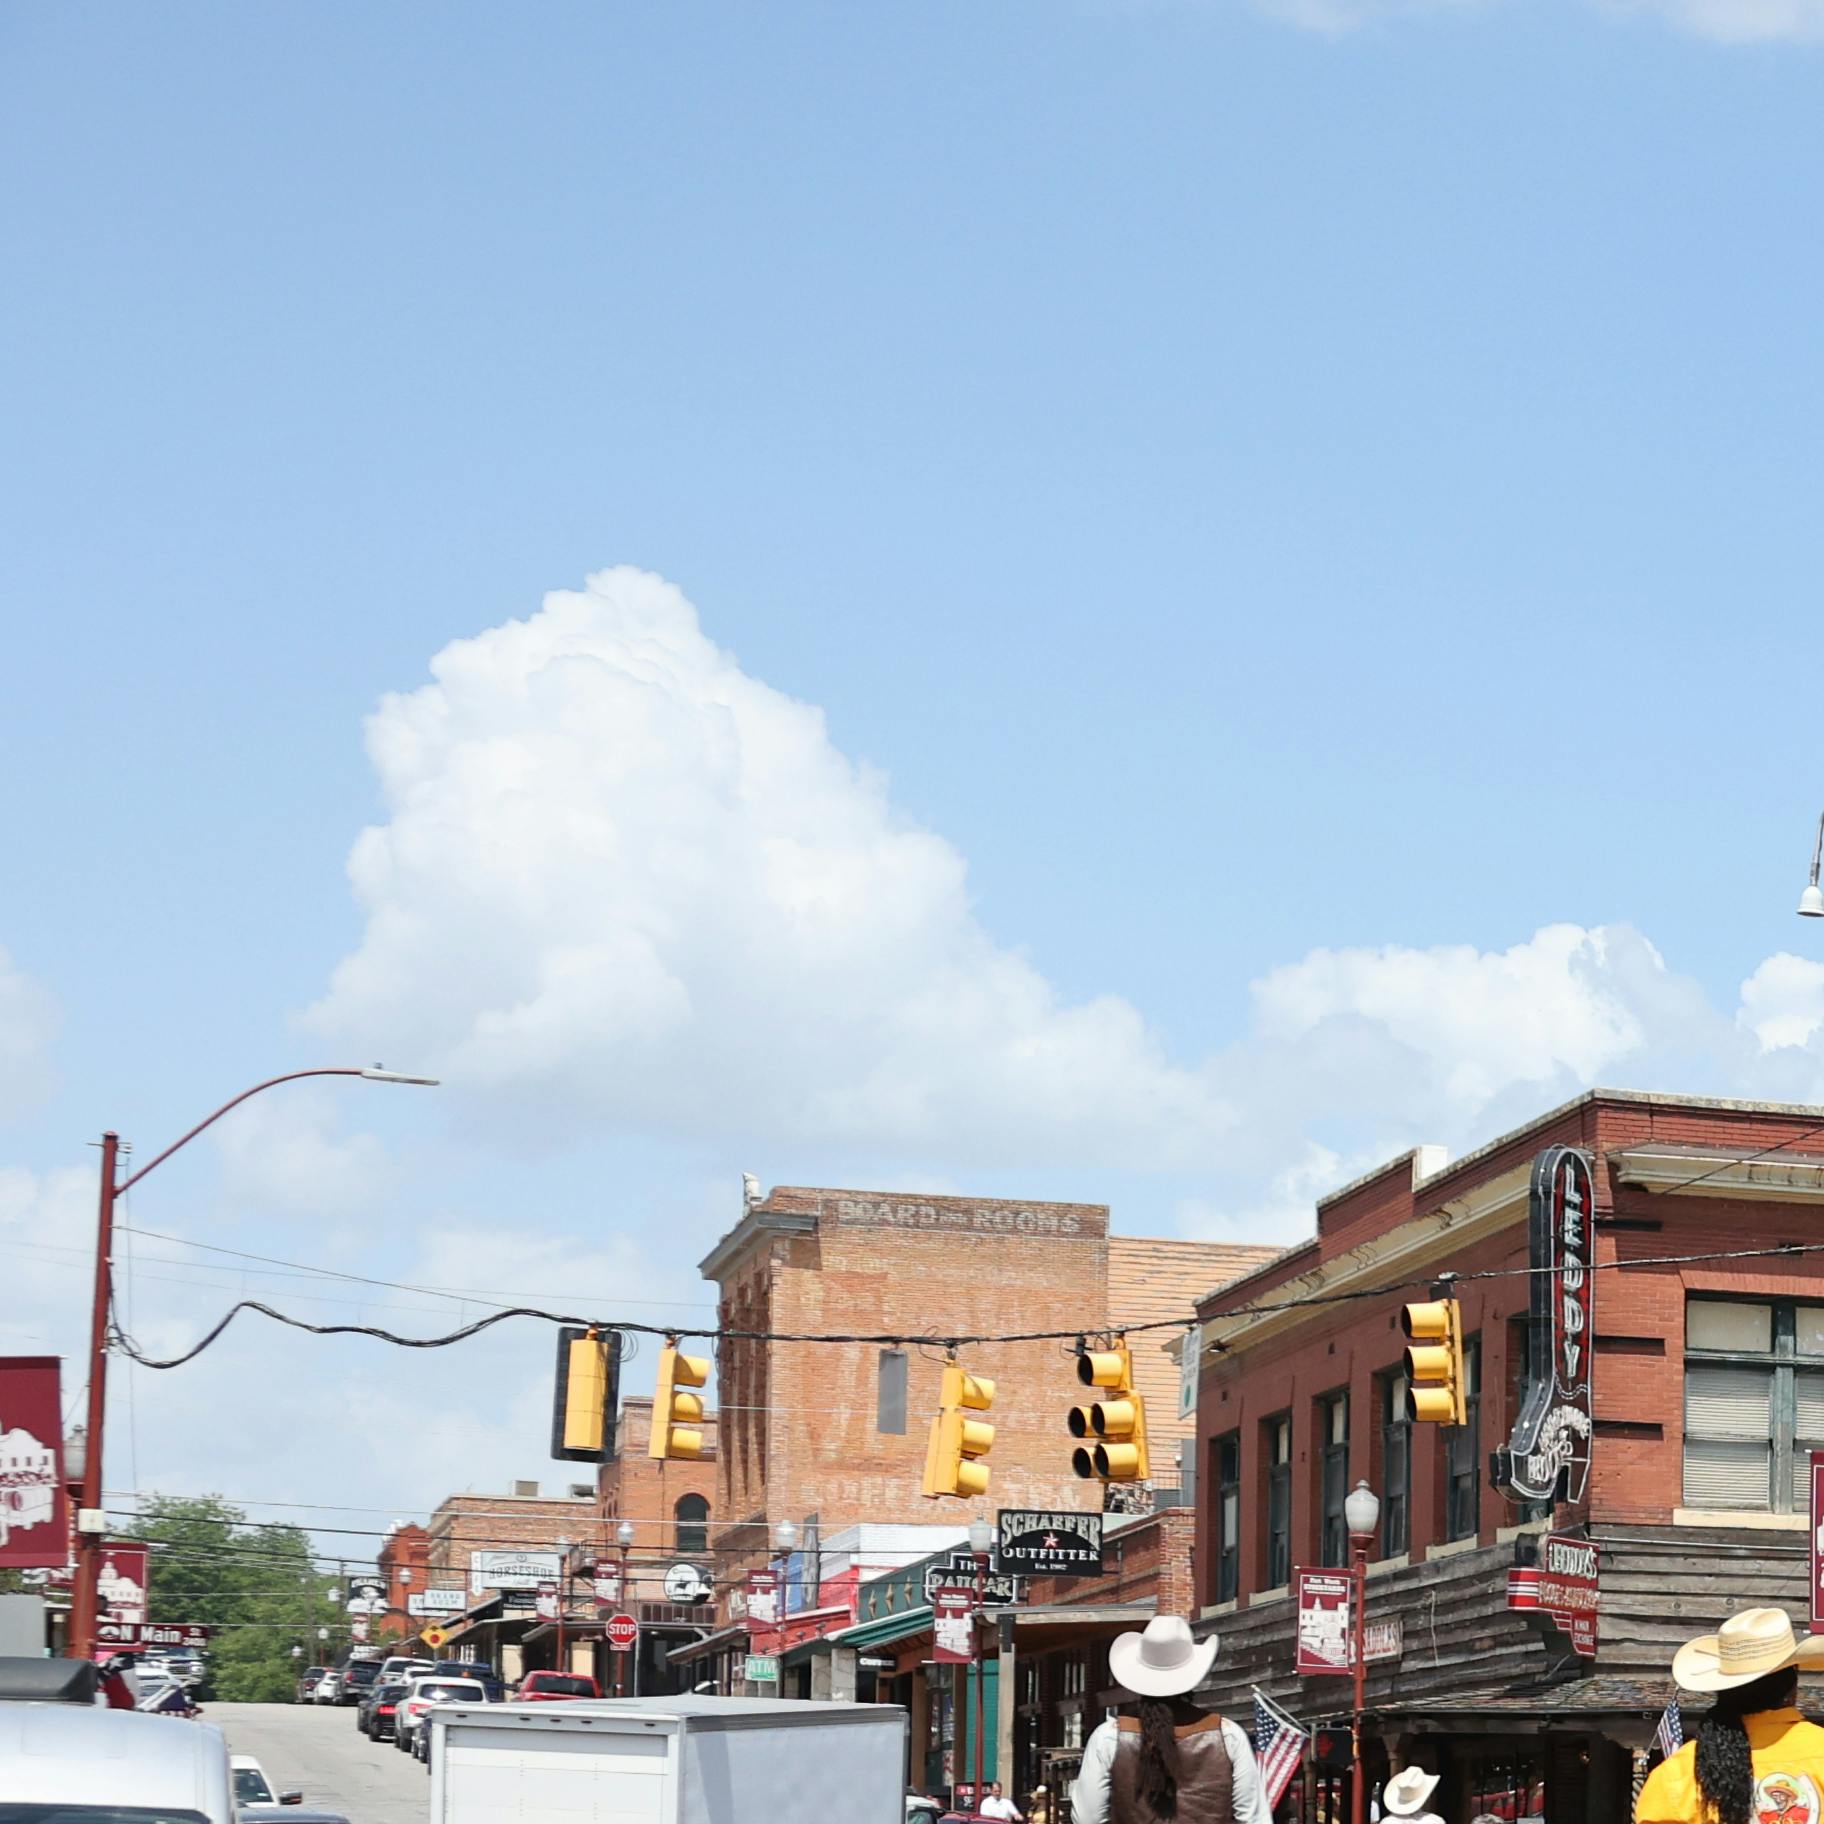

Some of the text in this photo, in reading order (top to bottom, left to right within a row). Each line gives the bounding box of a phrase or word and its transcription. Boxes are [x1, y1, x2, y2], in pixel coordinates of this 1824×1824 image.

[1564, 1163, 1584, 1378] LEDDY
[1001, 1512, 1101, 1550] SCHAEFER
[1002, 1548, 1100, 1561] OUTFITTER
[489, 1565, 554, 1580] HORSESHOE
[119, 1628, 134, 1640] N
[141, 1627, 183, 1642] Main
[609, 1624, 636, 1635] STOP
[749, 1660, 775, 1672] ATM
